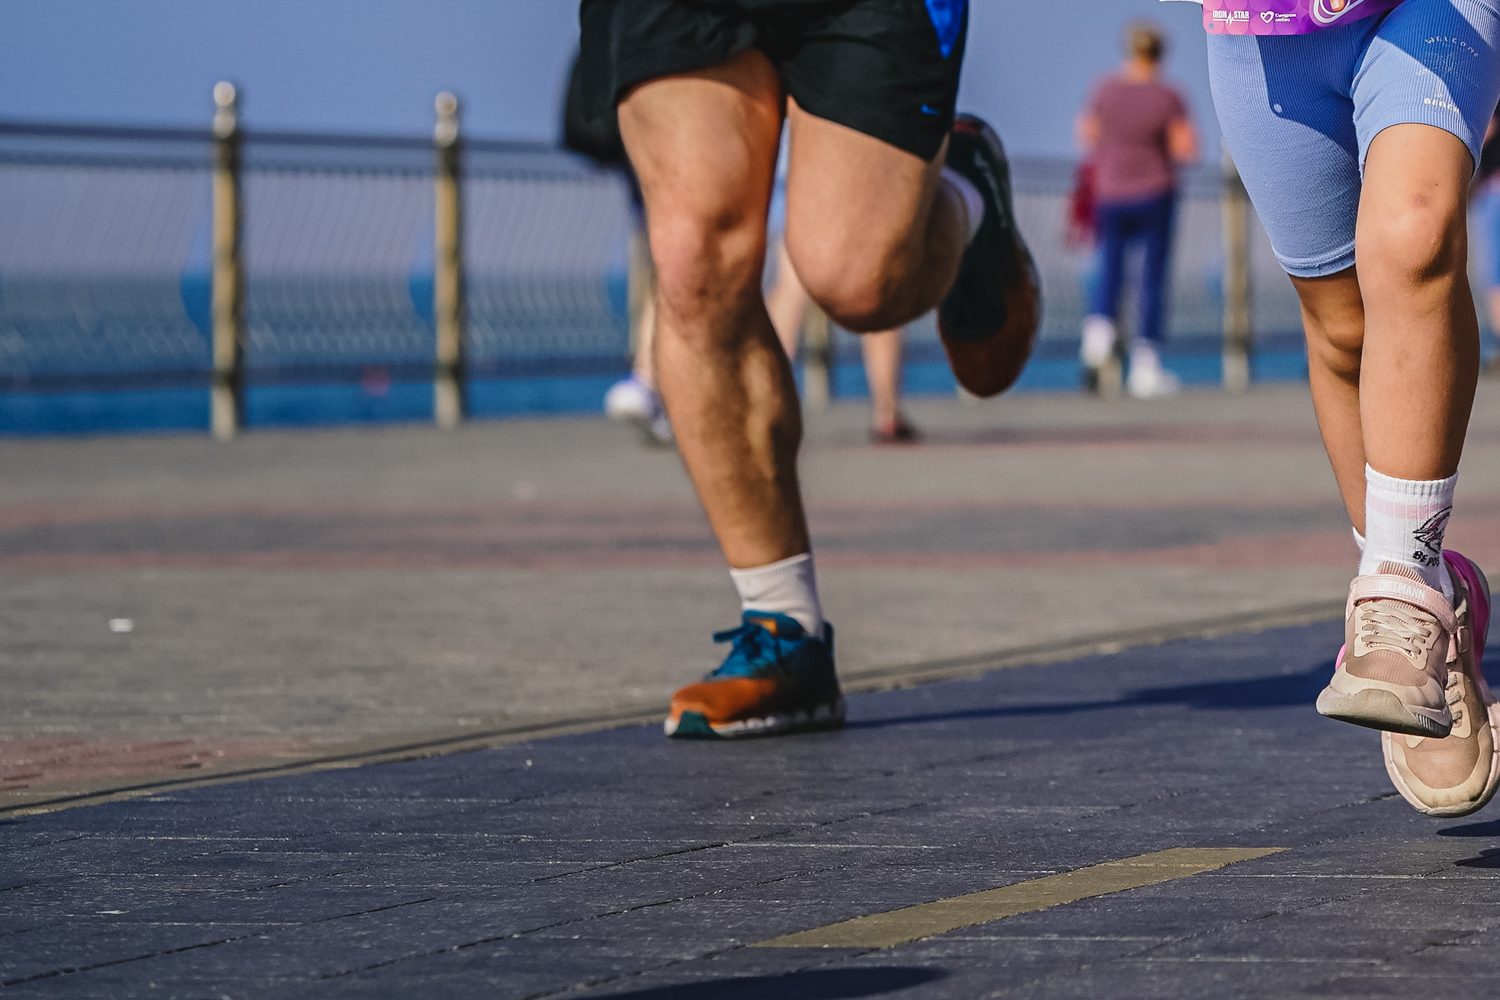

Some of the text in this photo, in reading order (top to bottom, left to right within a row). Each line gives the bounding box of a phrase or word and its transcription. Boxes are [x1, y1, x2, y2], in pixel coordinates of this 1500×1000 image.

[1212, 10, 1250, 19] IRON STAR
[1379, 580, 1426, 600] ORTMANN
